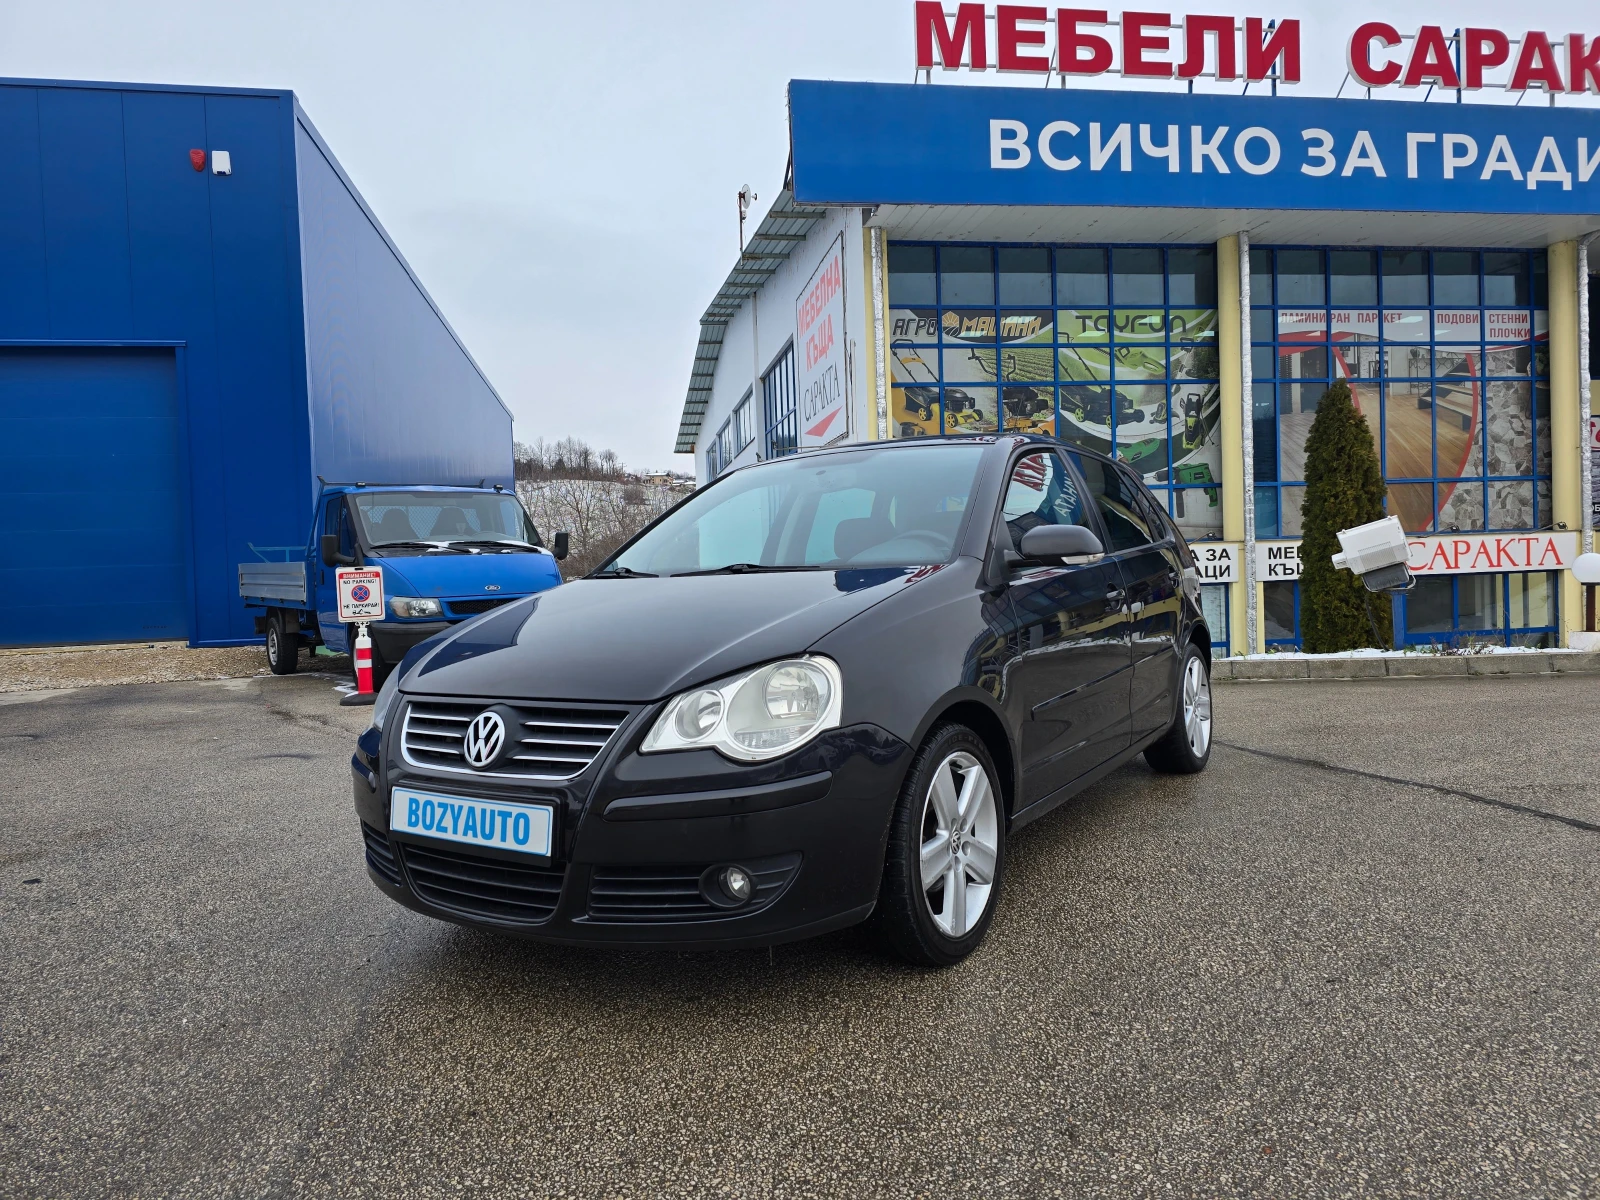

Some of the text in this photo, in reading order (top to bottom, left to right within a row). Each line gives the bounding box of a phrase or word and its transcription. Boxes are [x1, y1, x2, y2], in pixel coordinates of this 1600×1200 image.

[915, 0, 1600, 96] МЕБЕЛИ САРАК
[989, 118, 1600, 191] ВСИЧКО ЗА ГРАДИ
[798, 254, 841, 338] МЕБЕЛНА
[893, 317, 938, 338] АГРО
[1357, 312, 1402, 323] ПАРКЕТ
[1437, 313, 1528, 325] ПОДОВИ СТЕННИ
[1489, 327, 1530, 338] ПЛОЧКИ
[806, 313, 834, 373] КЪЩА
[803, 361, 841, 422] САРАКТА
[1205, 548, 1231, 561] ЗА
[1405, 536, 1564, 571] САРАКТА
[407, 797, 531, 846] BOZYAUTO
